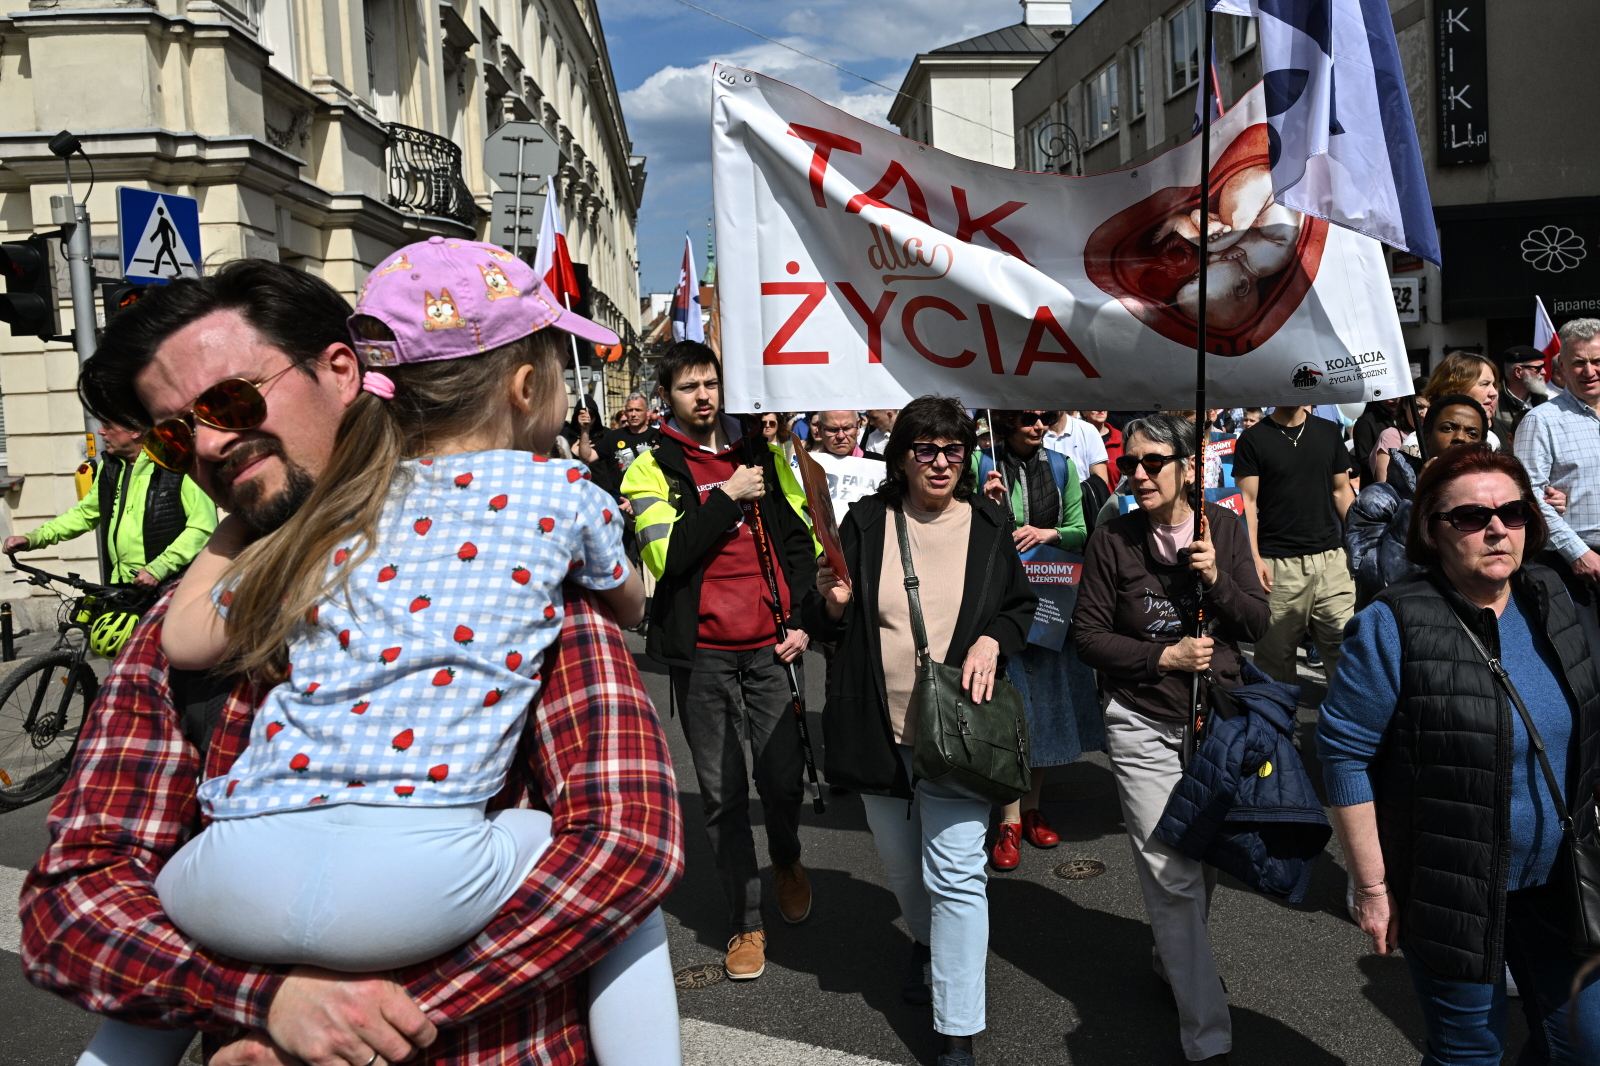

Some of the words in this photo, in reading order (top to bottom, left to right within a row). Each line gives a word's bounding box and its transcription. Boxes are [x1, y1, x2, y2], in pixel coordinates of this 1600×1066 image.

[786, 122, 1037, 268] TAK
[867, 223, 954, 285] dla
[760, 260, 1102, 379] ŻYCIA
[1325, 351, 1385, 371] KOALICJA
[1329, 374, 1352, 385] ŻYCIA
[1357, 368, 1387, 380] RODZINY
[1023, 563, 1074, 574] HROŃMY
[1028, 575, 1073, 583] AŁŻEŃSTWO!
